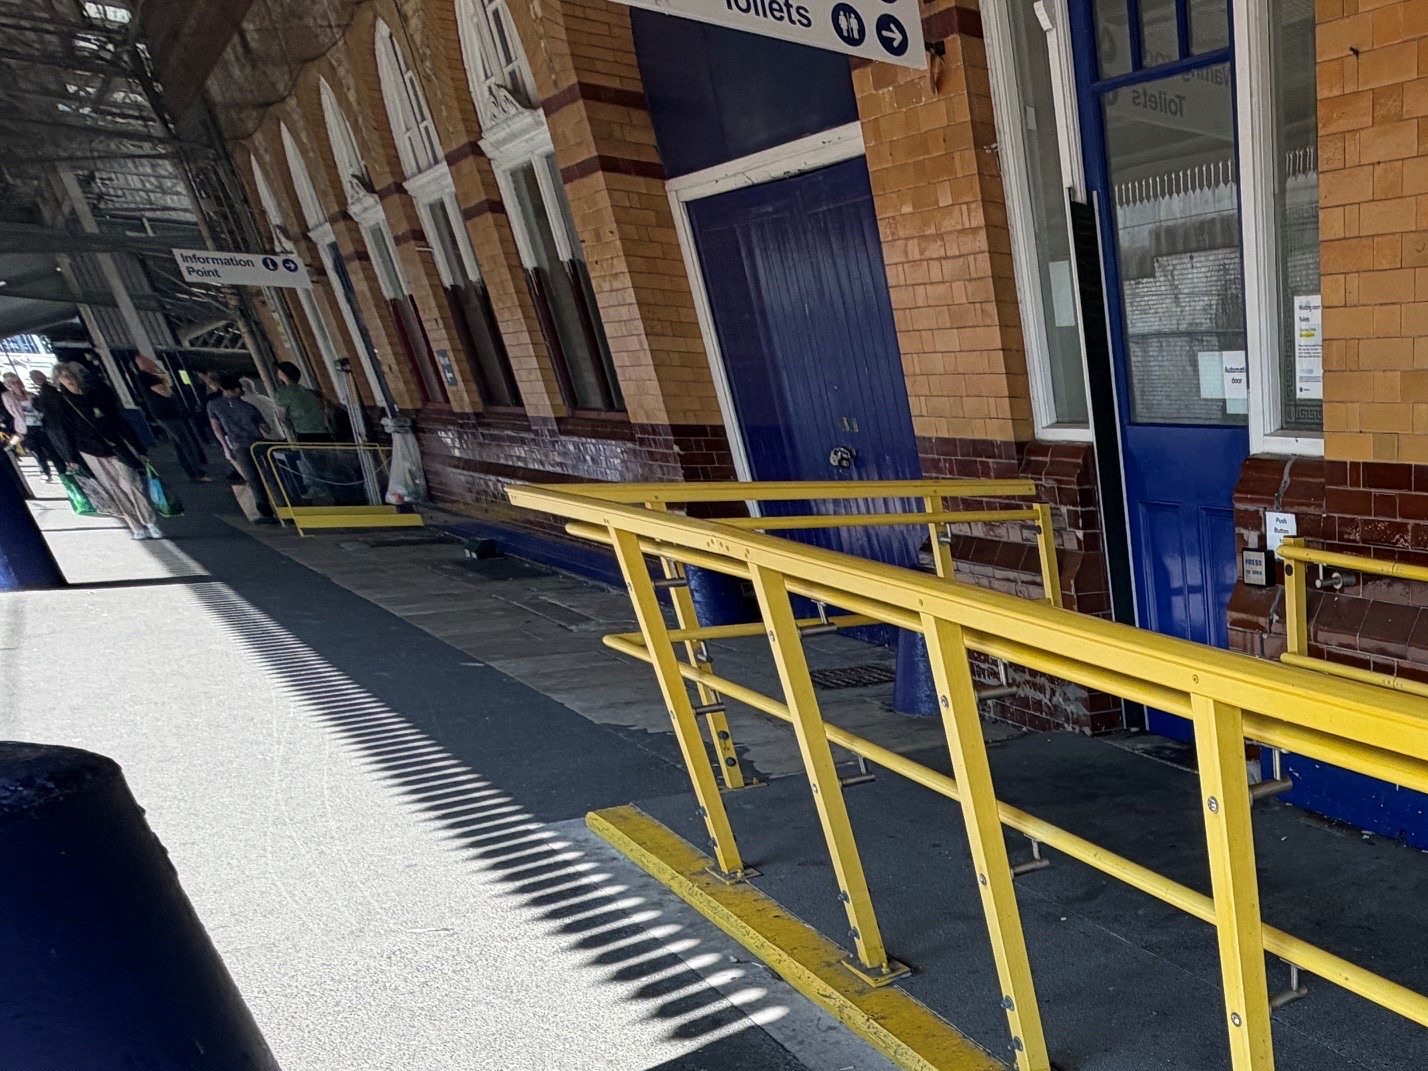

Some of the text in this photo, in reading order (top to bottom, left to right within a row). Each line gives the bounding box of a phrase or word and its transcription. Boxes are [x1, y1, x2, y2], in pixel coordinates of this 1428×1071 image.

[180, 252, 255, 268] Information
[186, 265, 222, 278] Point
[1275, 517, 1287, 525] Push
[1273, 526, 1289, 535] Button
[1245, 558, 1263, 567] PRESS
